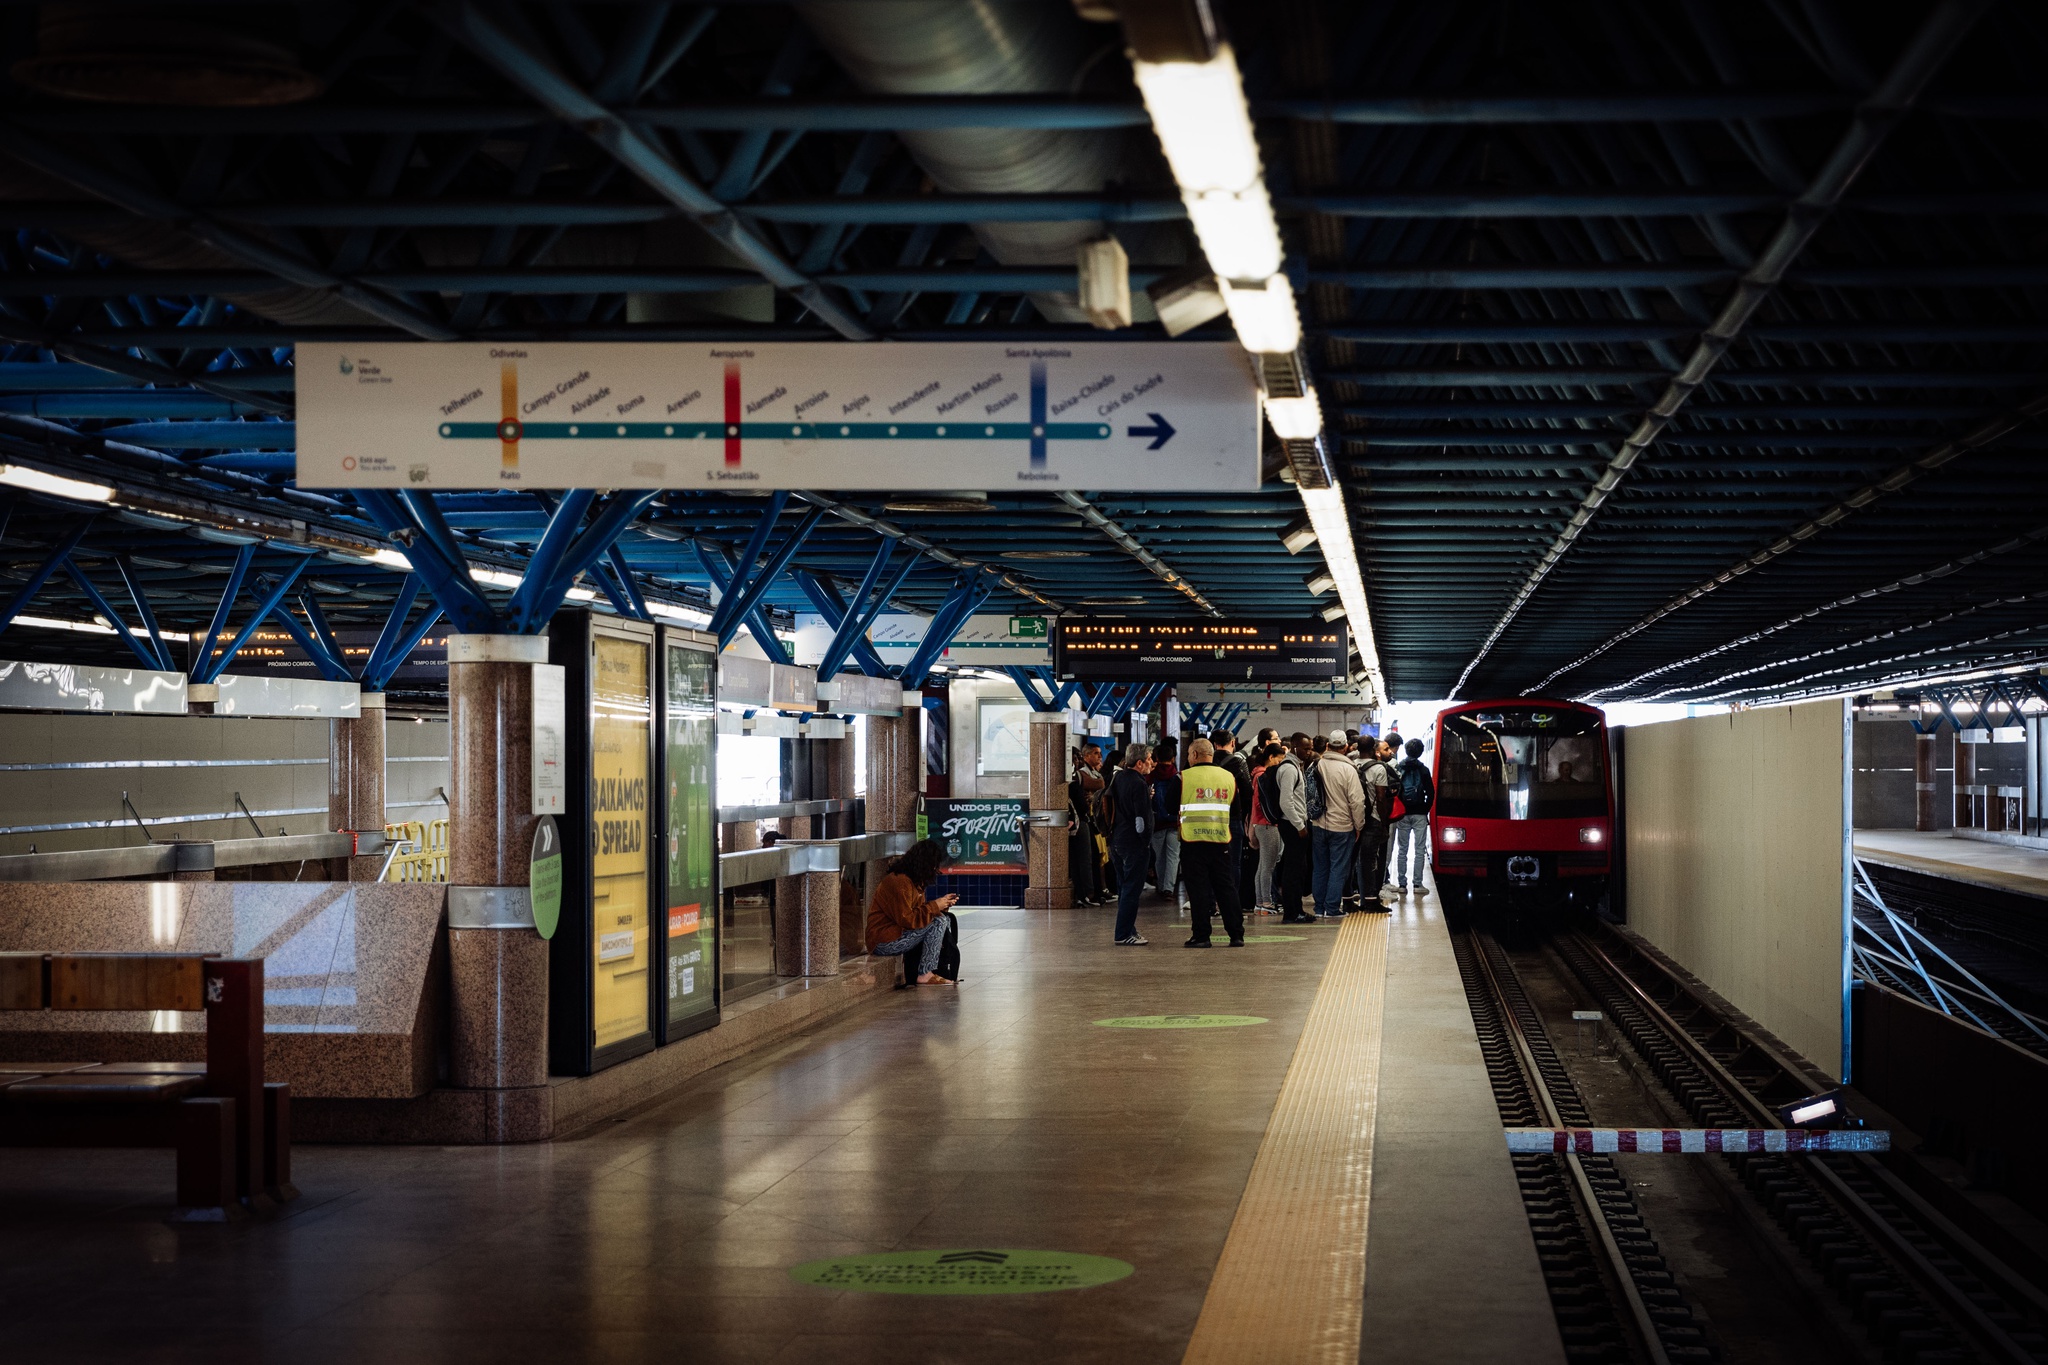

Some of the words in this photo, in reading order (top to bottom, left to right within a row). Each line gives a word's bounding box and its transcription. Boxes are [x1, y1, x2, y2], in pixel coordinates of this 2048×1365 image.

[489, 349, 528, 359] Odivelas
[709, 349, 755, 360] Aeroporto
[1005, 349, 1030, 358] Santa
[359, 366, 381, 375] Verde
[439, 387, 484, 417] Telheiras
[522, 390, 557, 416] Campo
[555, 369, 591, 395] Grande
[570, 386, 611, 416] Alvalade
[665, 389, 702, 415] Areeiro
[746, 386, 788, 416] Alameda
[794, 389, 830, 415] Arroios
[888, 381, 941, 416] Intendente
[936, 390, 973, 416] Martim
[970, 372, 1003, 396] Moniz
[1051, 374, 1116, 416] Baixa-Chiado
[1097, 398, 1121, 417] Cais
[1119, 391, 1135, 404] do
[1133, 373, 1165, 396] Sodré
[616, 394, 646, 416] Roma
[841, 394, 871, 415] Anjos
[984, 391, 1019, 416] Rossio
[500, 471, 521, 480] Rato
[707, 471, 715, 480] S.
[717, 470, 760, 481] Sebastião
[1017, 471, 1060, 481] Reboleira
[873, 630, 886, 640] Campo
[884, 623, 897, 633] Grande
[889, 629, 904, 640] Alvalade
[268, 660, 291, 668] PRÓXIMO
[1538, 714, 1547, 728] 2
[593, 768, 644, 812] BAIXÁMOS
[1195, 788, 1228, 799] 2045
[949, 804, 991, 812] UNIDOS
[994, 804, 1021, 812] PELO
[602, 819, 641, 855] SPREAD
[991, 844, 1022, 852] BETANO
